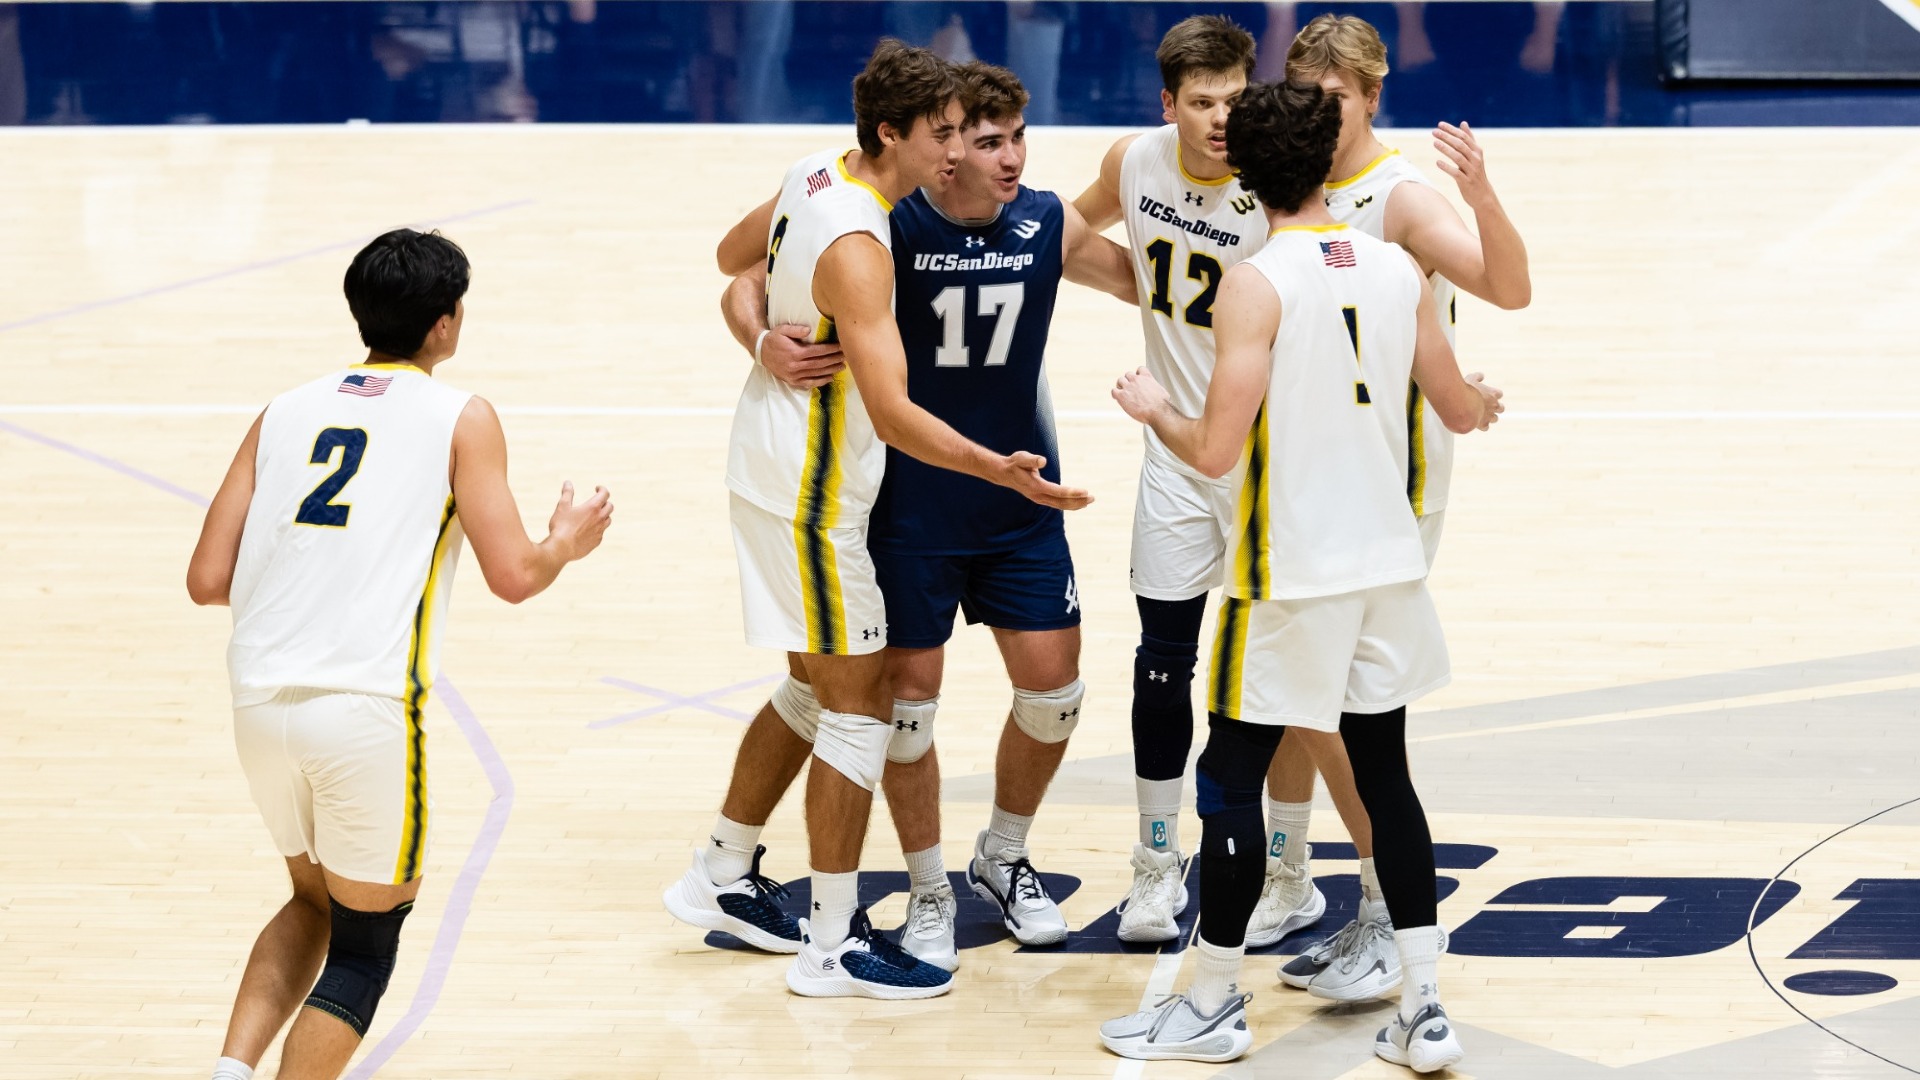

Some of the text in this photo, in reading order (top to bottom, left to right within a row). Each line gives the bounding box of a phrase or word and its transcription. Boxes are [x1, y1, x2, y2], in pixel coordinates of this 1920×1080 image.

[913, 252, 1034, 271] UCSanDiego
[1139, 195, 1241, 247] UCSanDiego
[930, 281, 1025, 368] 17
[1145, 235, 1225, 330] 12
[292, 424, 370, 530] 2
